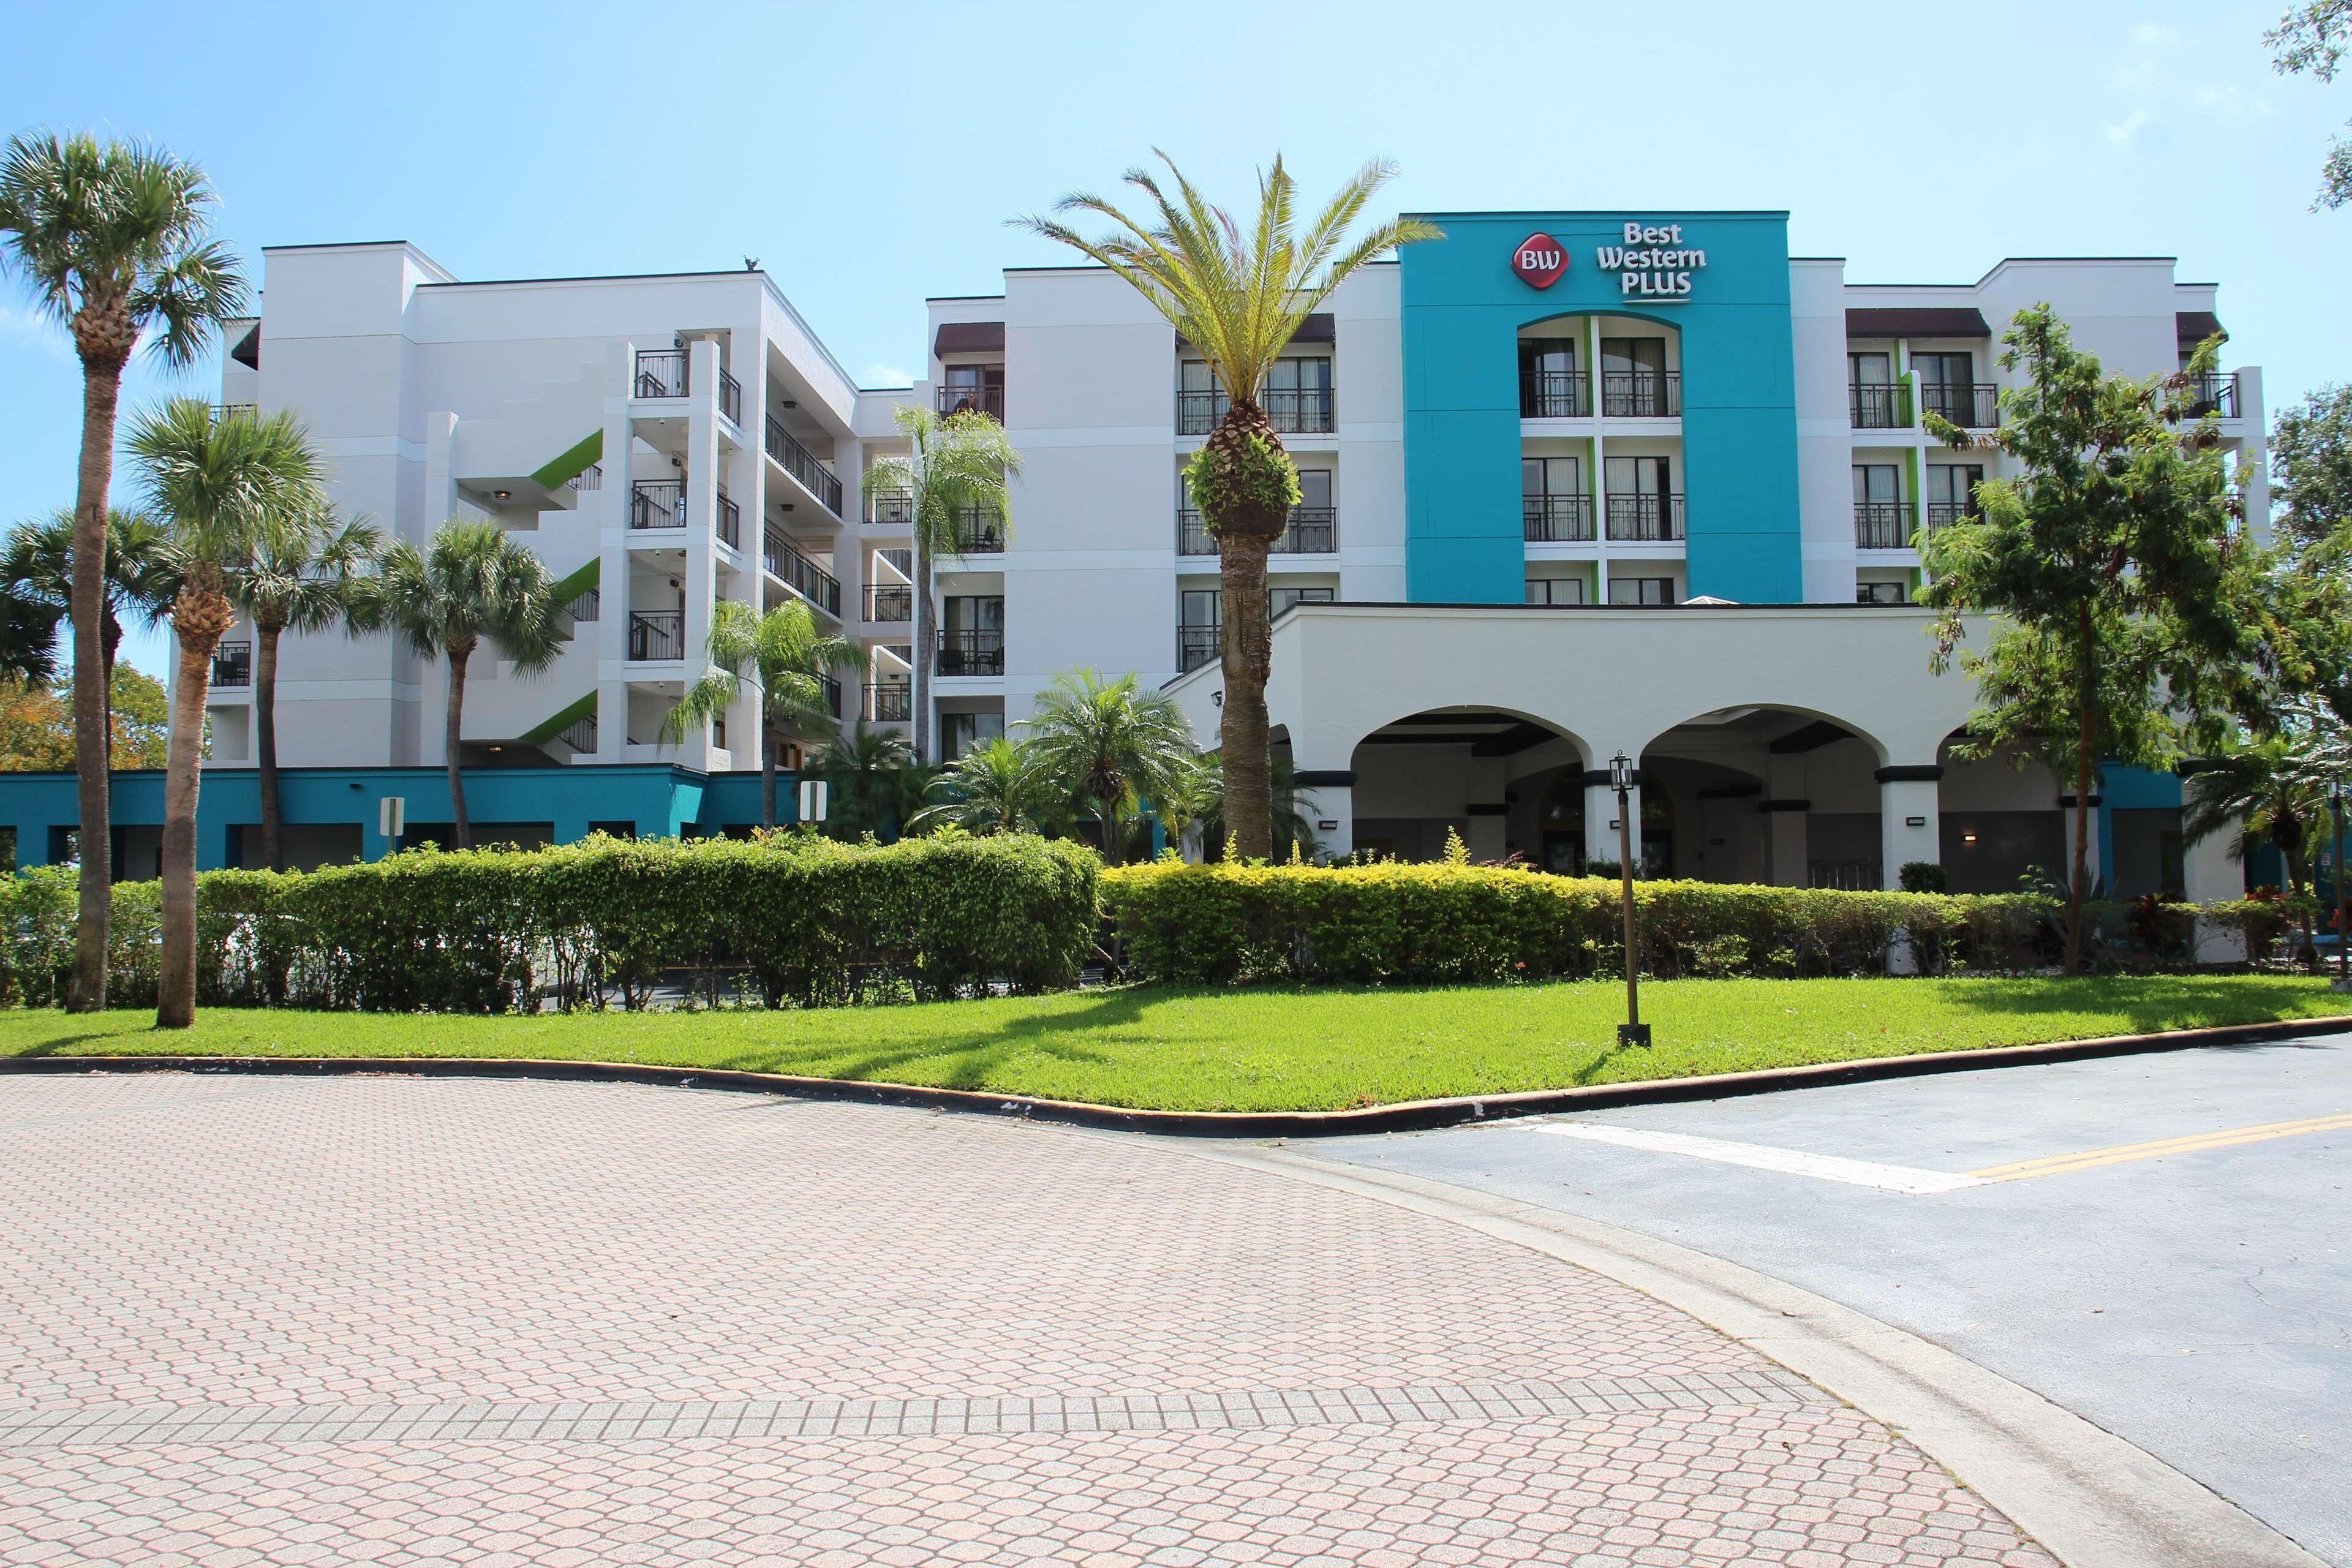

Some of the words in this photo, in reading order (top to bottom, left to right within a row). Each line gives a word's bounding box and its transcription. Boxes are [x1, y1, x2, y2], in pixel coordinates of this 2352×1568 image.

[1624, 222, 1683, 244] Best
[1521, 250, 1560, 270] BW
[1597, 247, 1707, 270] Western
[1622, 272, 1691, 295] PLUS
